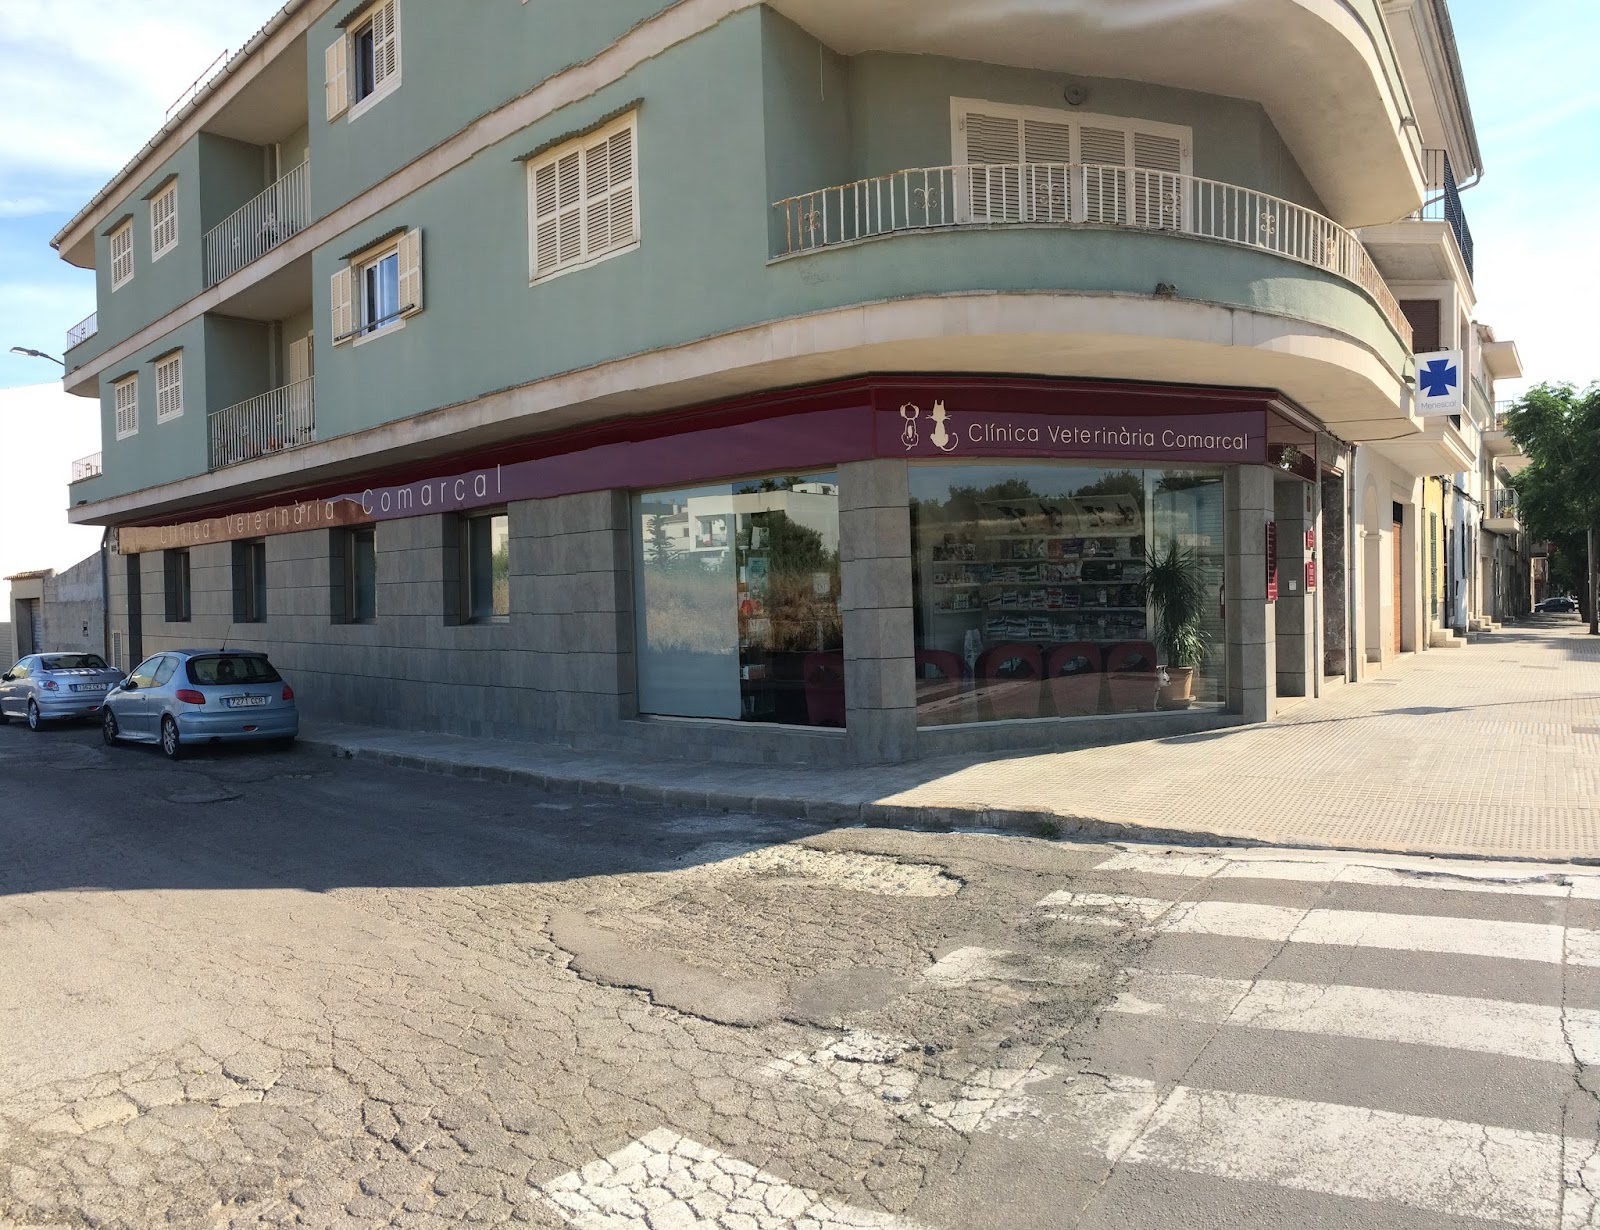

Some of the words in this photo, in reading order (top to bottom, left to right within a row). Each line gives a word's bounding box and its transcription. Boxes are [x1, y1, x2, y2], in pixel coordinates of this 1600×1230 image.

[1421, 400, 1457, 410] Menescal
[968, 423, 1039, 442] Clínica
[1047, 425, 1154, 446] Veterinària
[1161, 429, 1249, 450] Comarcal
[160, 522, 210, 544] Clínica
[225, 498, 334, 534] Veterinària
[361, 463, 501, 515] Comarcal
